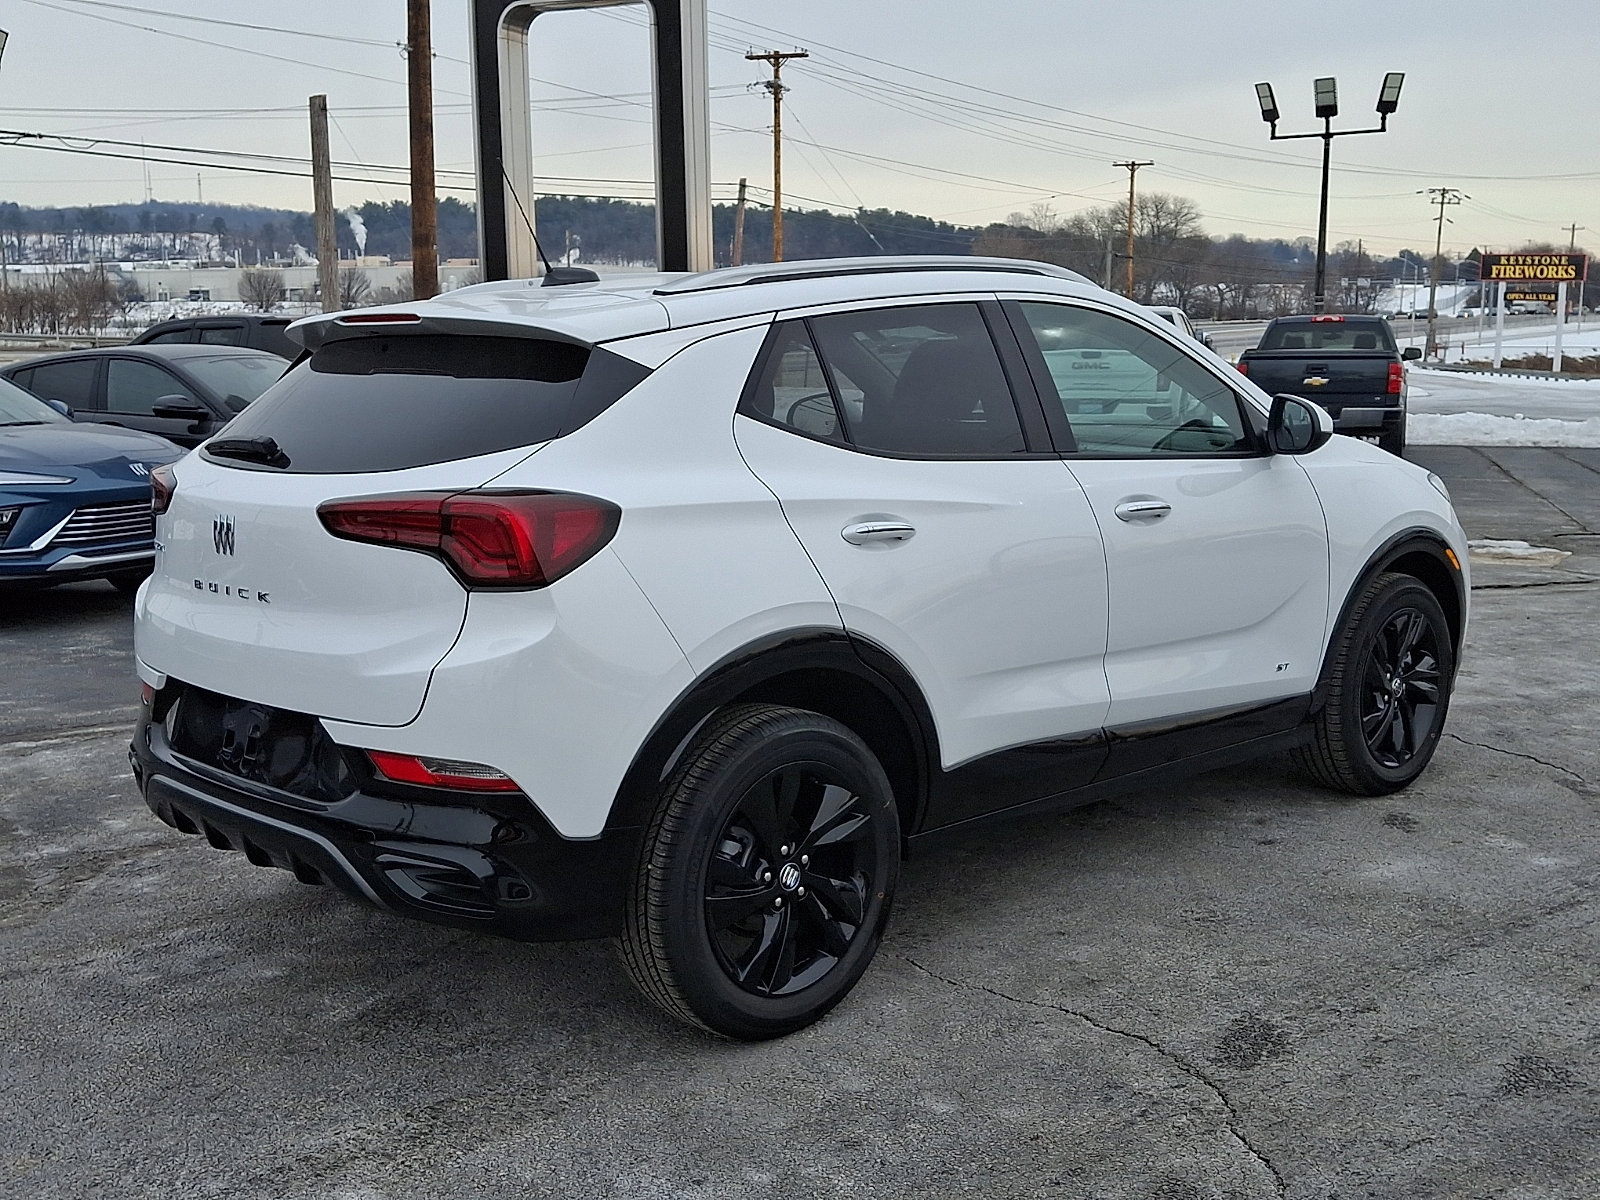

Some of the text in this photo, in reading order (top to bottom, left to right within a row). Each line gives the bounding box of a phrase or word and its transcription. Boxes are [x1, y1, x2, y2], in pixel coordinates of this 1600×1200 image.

[1500, 256, 1569, 265] KEYSTONE
[1491, 265, 1576, 279] FIREWORKS
[1538, 293, 1556, 301] YEAR
[194, 579, 271, 603] BUICK
[1275, 662, 1291, 672] ST
